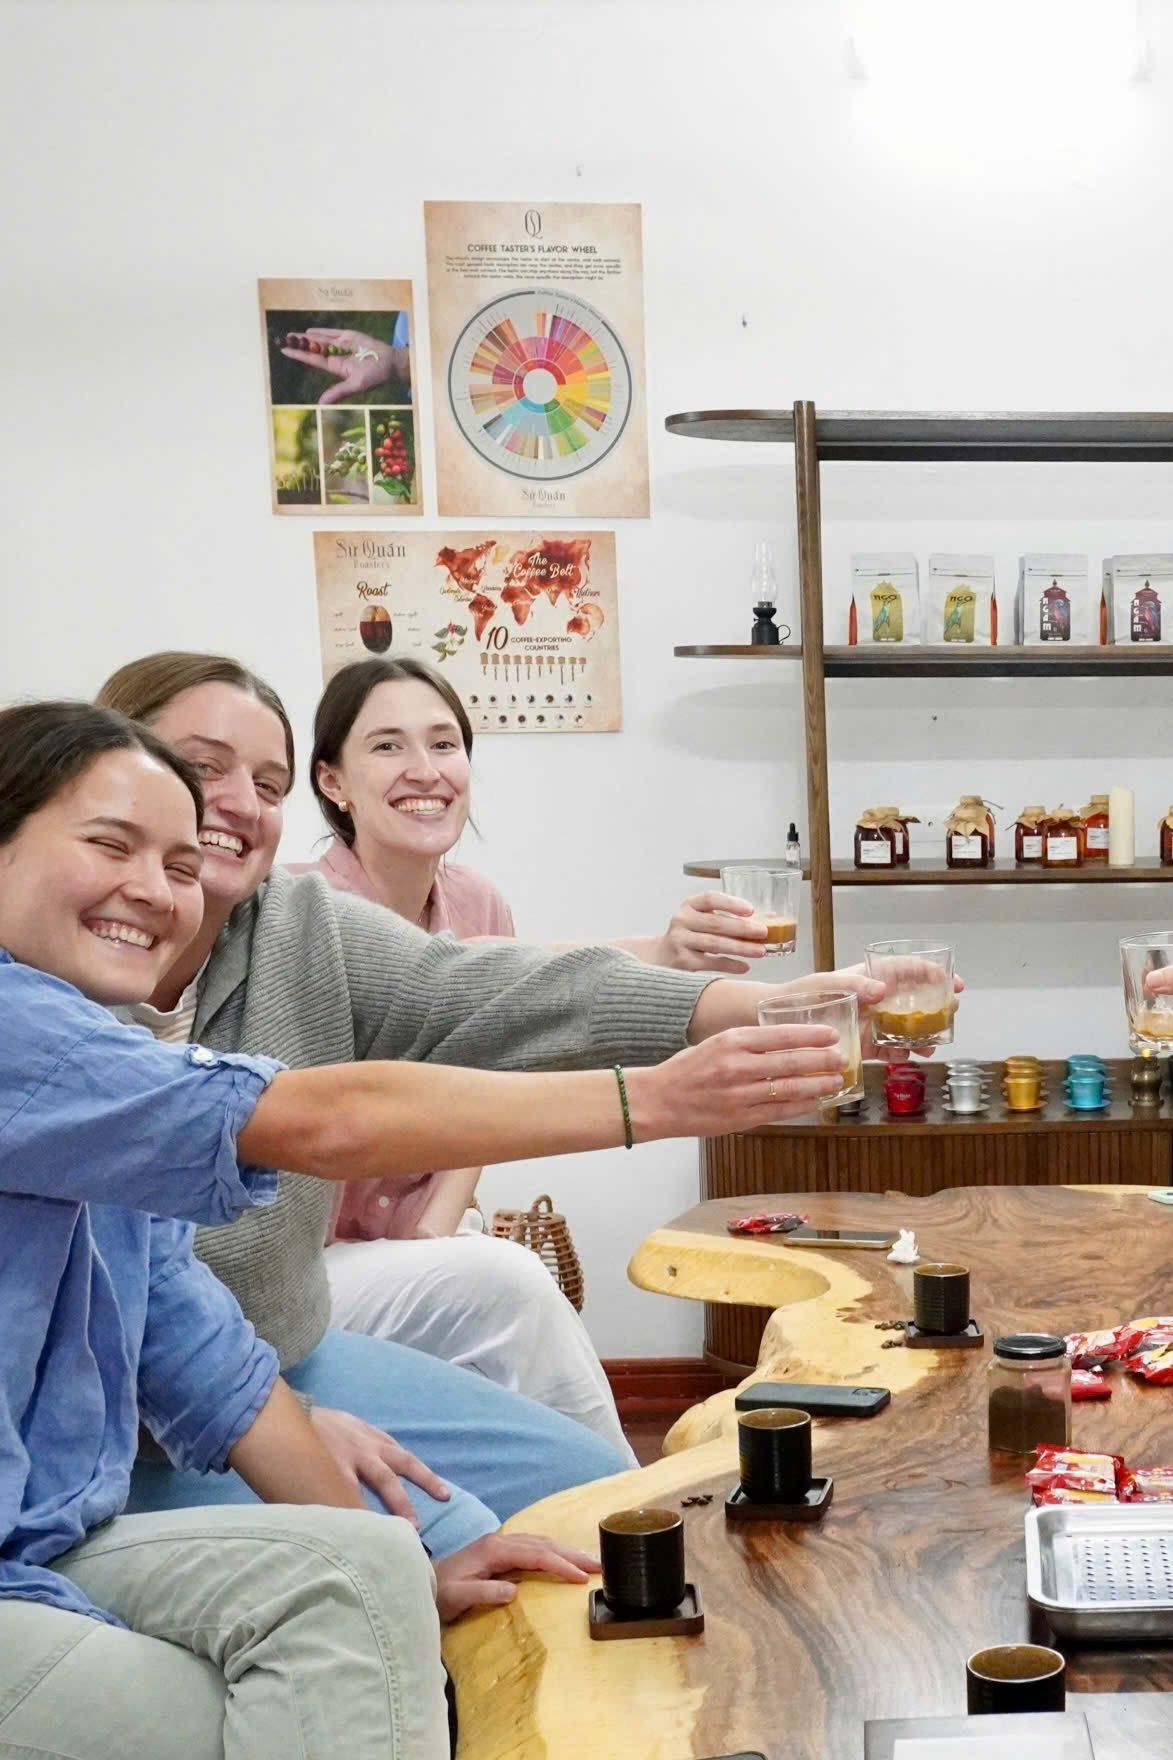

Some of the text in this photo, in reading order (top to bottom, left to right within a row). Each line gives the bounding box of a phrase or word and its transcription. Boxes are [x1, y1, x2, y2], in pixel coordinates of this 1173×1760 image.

[467, 244, 598, 254] COFFEE TASTER'S FLAVOR WHEEL
[528, 552, 548, 565] The
[513, 563, 577, 579] Coffee Belt
[357, 581, 392, 601] Roast
[486, 625, 509, 650] 10
